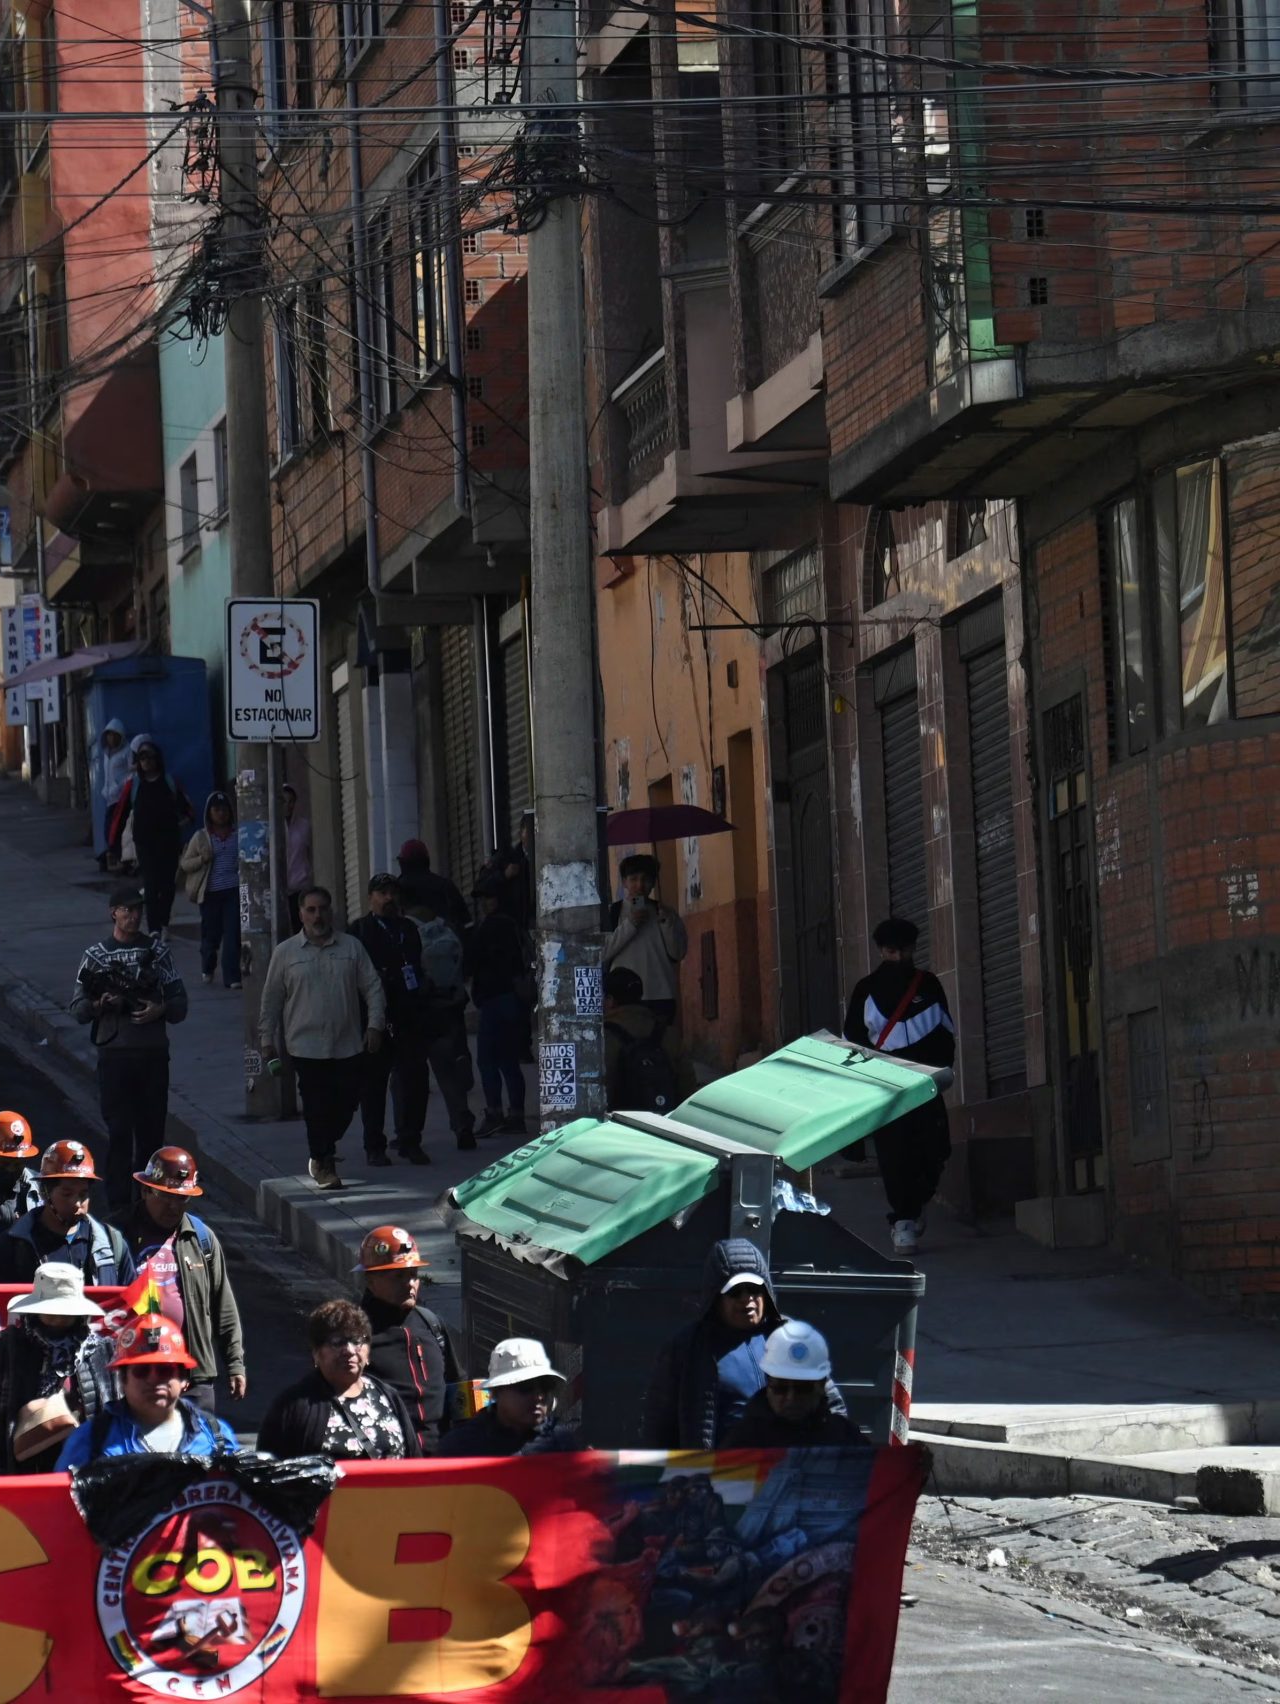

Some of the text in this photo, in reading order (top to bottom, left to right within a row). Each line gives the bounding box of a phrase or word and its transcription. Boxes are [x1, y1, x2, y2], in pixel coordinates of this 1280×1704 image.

[8, 608, 20, 716] FARMAIA
[265, 689, 282, 702] NO
[235, 708, 312, 722] ESTACIONAR
[577, 968, 586, 977] TE
[578, 978, 584, 986] A
[577, 987, 591, 997] TU
[132, 1546, 276, 1596] COB
